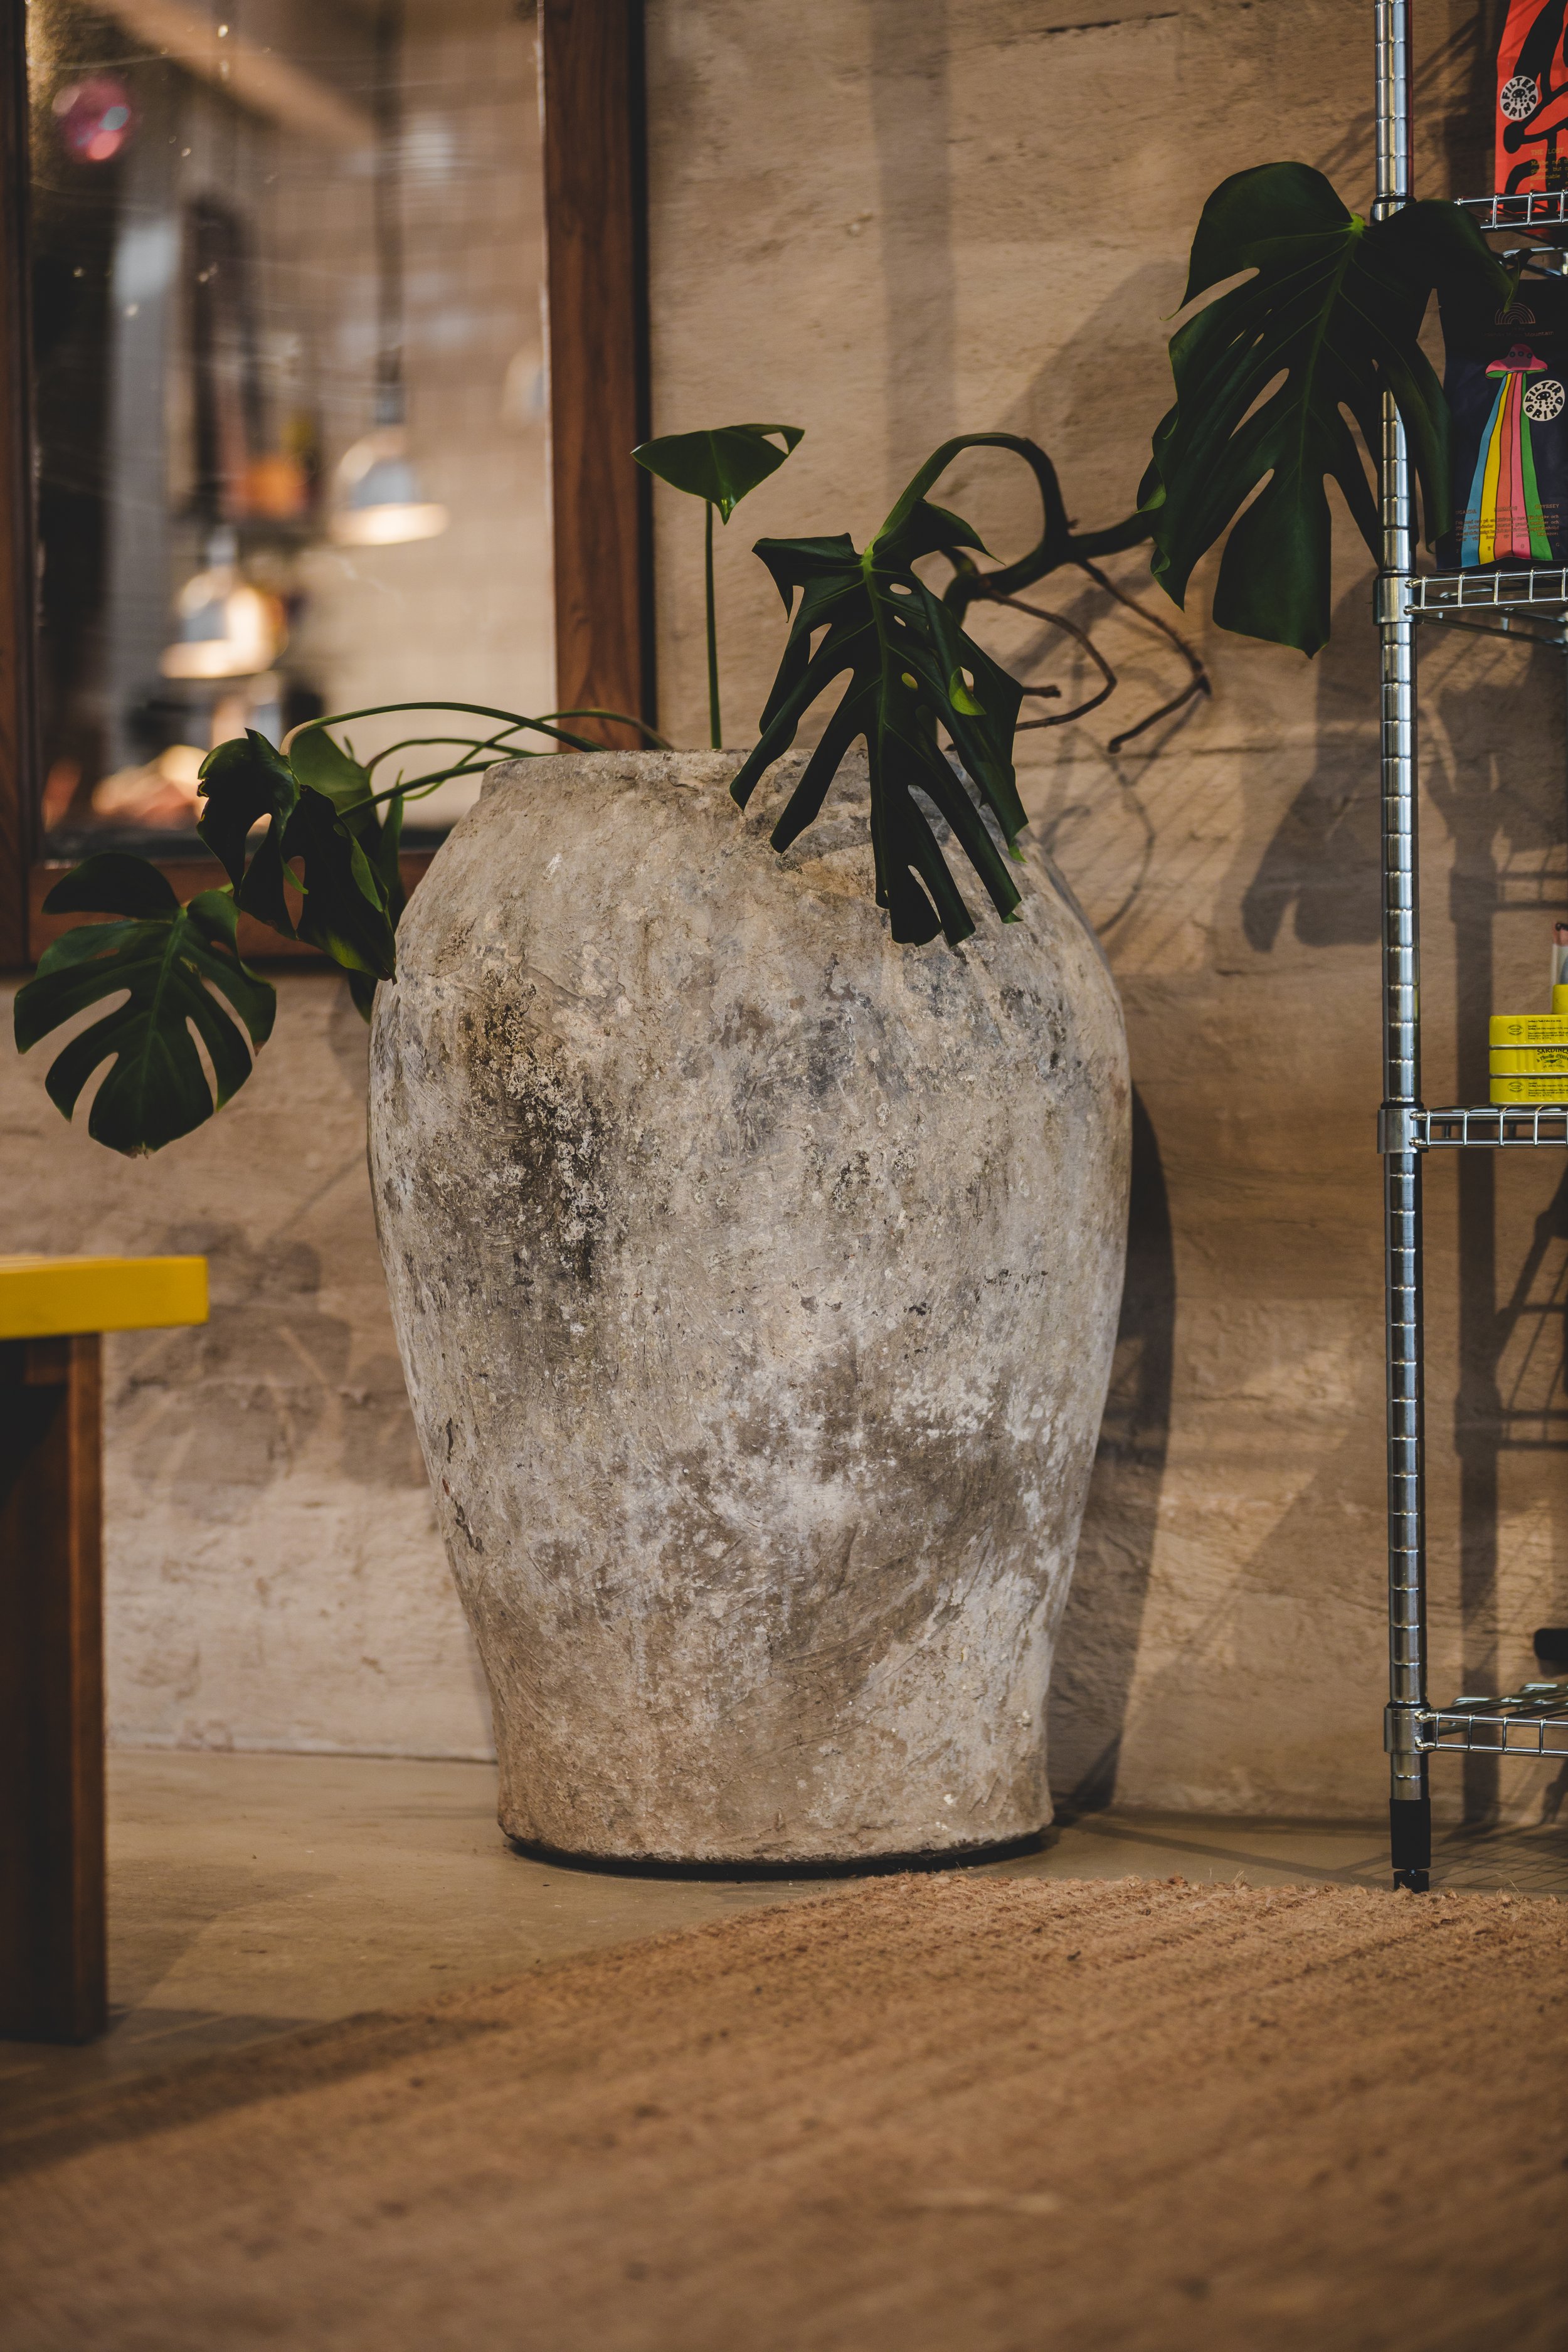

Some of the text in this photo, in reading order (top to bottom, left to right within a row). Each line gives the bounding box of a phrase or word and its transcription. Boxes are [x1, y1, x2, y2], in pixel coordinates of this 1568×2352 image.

[1502, 77, 1535, 100] FILTER
[1503, 94, 1537, 118] GRIND
[1525, 382, 1561, 402] FILTER
[1525, 396, 1563, 420] GRIND
